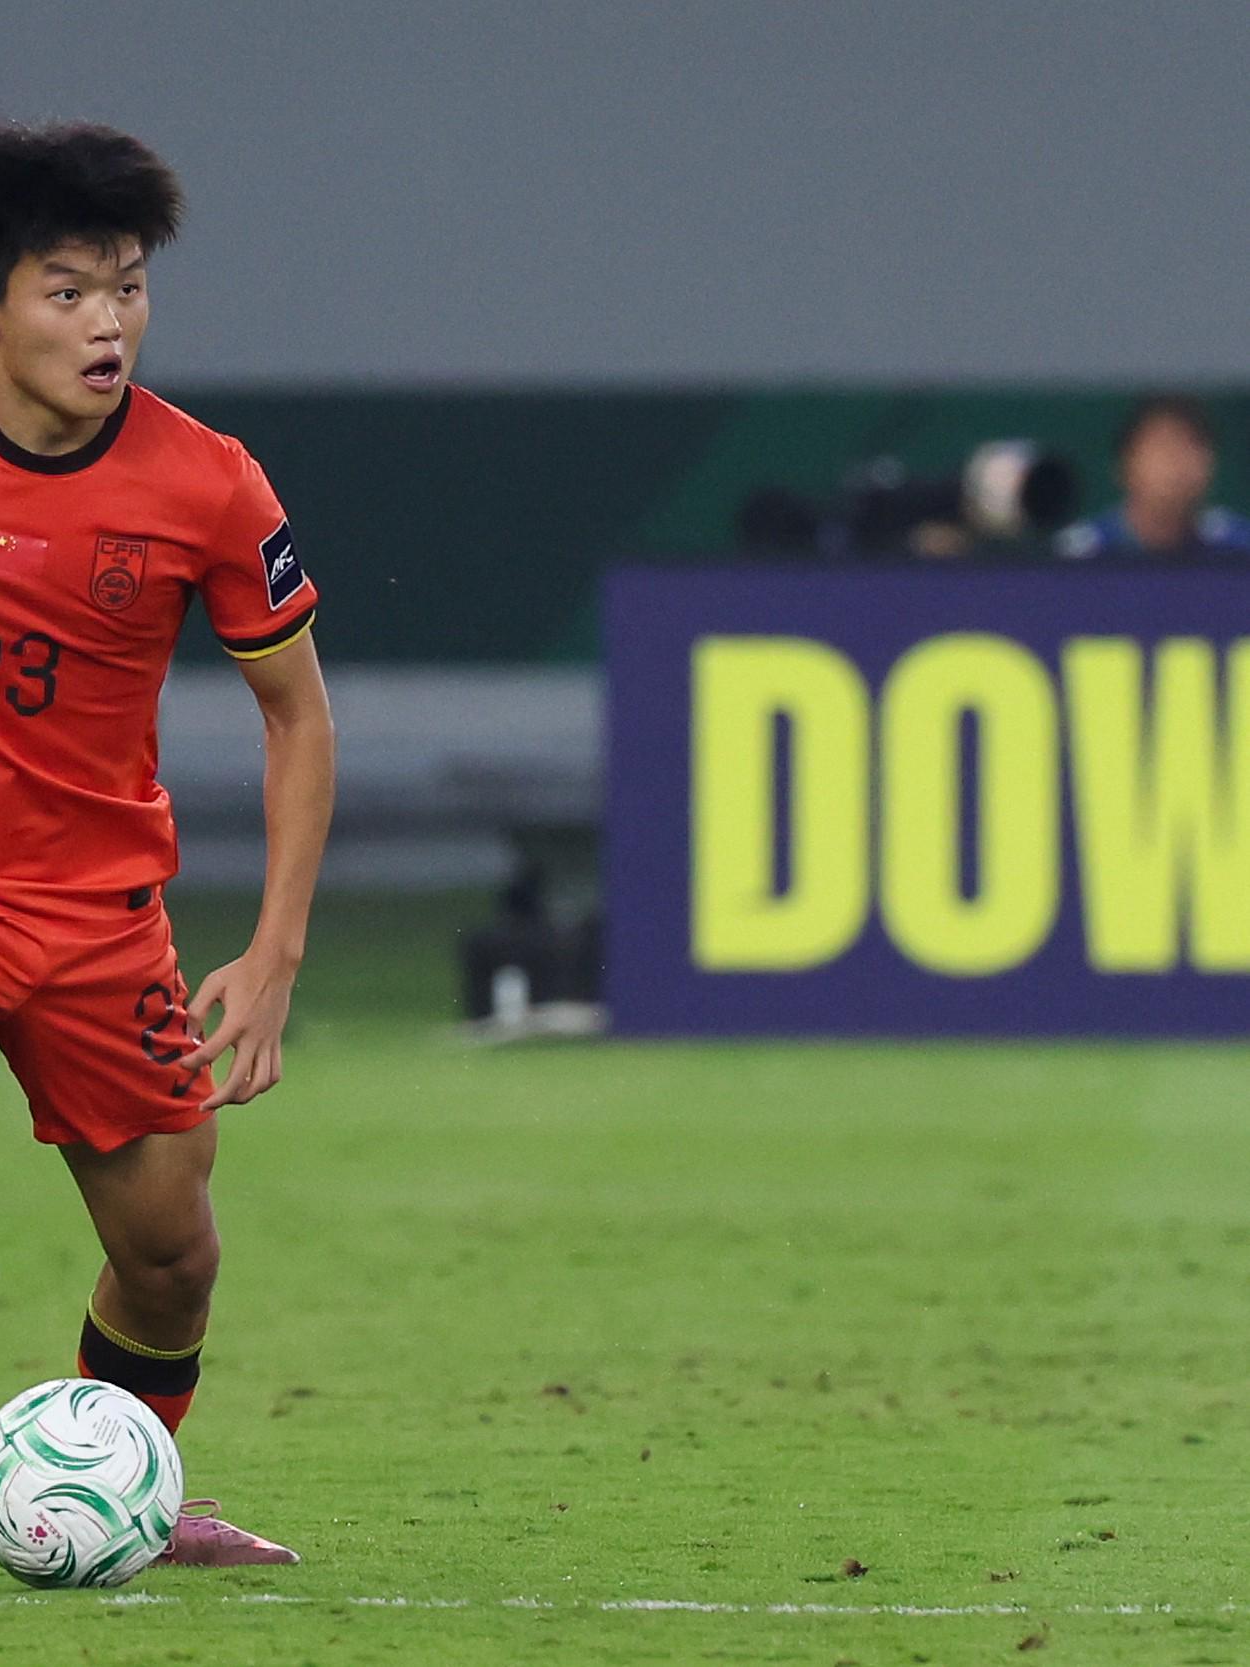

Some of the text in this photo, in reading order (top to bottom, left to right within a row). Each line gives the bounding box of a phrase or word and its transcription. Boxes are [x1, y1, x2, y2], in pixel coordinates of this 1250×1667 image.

[101, 541, 143, 557] CFA
[270, 543, 295, 581] AFC
[691, 633, 1250, 976] DOW
